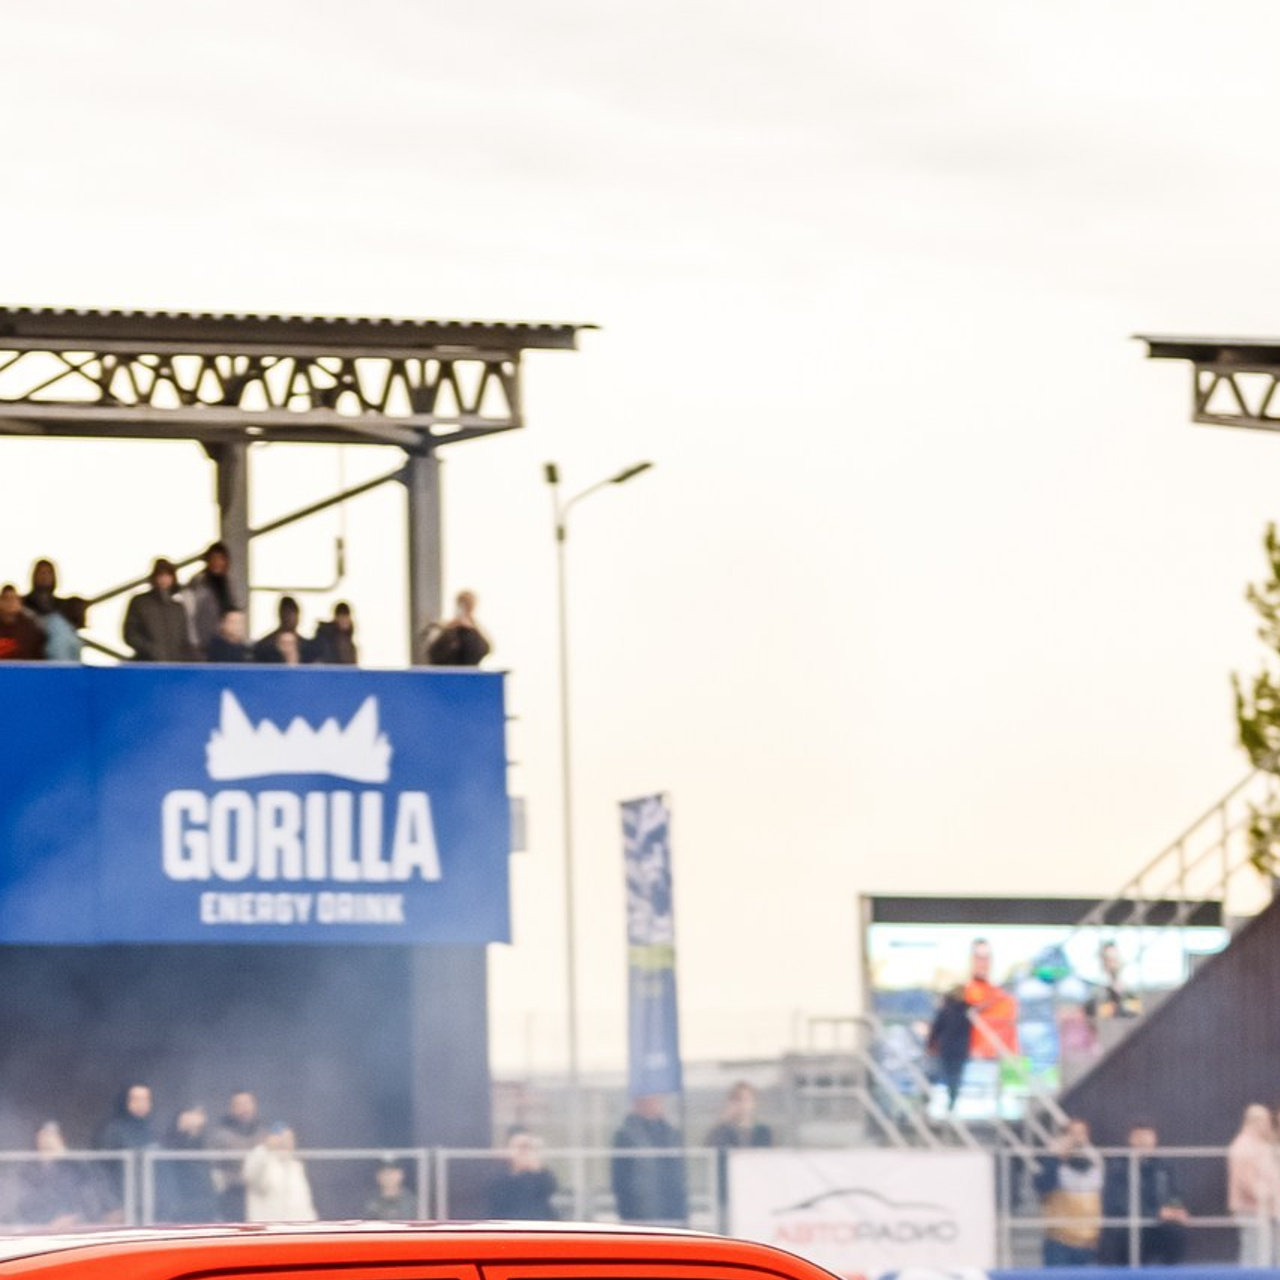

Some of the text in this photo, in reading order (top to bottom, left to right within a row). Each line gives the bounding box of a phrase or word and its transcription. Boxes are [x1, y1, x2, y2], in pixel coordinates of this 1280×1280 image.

[162, 789, 441, 883] GORILLA
[201, 892, 404, 924] ENERGY DRINK
